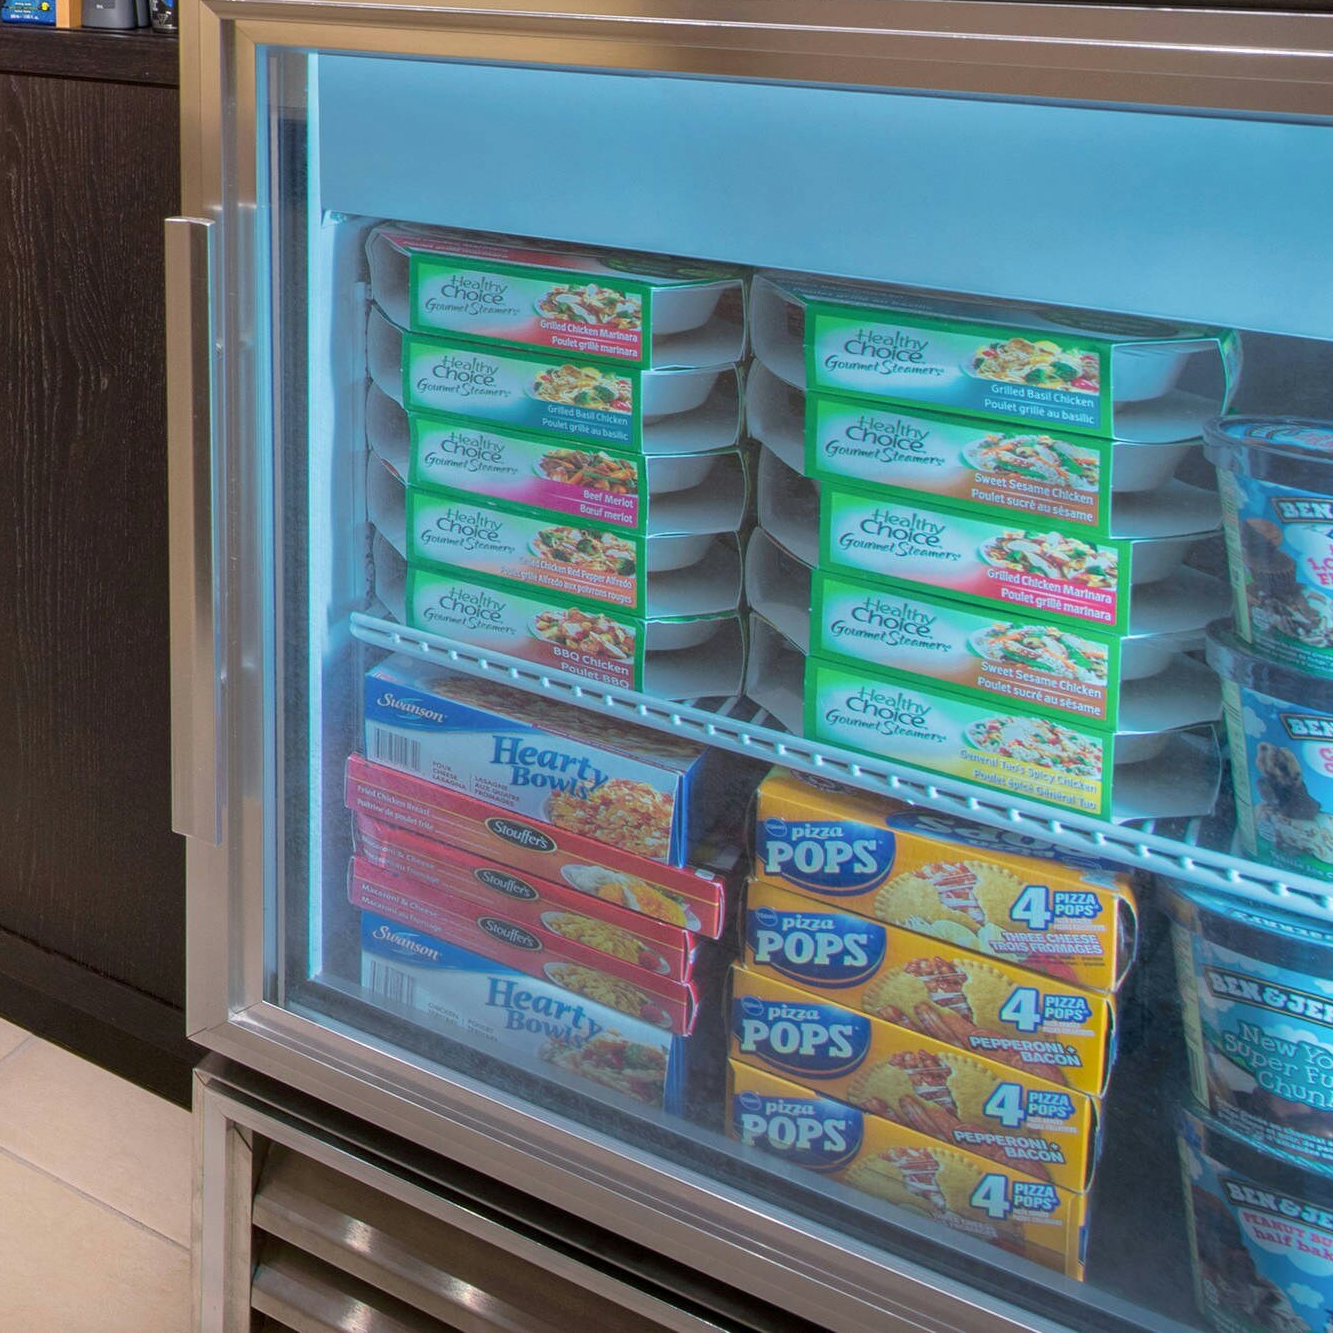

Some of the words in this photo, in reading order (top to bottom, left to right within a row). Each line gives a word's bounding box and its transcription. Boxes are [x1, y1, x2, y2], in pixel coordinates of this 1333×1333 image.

[441, 284, 505, 306] Choice
[451, 274, 508, 294] Healthy
[425, 297, 468, 316] Gourmet
[540, 319, 565, 332] Grilled
[567, 322, 597, 337] Chicken
[600, 327, 638, 342] Marinara
[583, 490, 601, 500] Beef
[603, 493, 634, 508] Merlot
[377, 692, 444, 724] Swanson
[490, 736, 608, 787] Hearty
[509, 766, 589, 801] Bowls
[493, 820, 547, 848] Stouffer's
[791, 823, 844, 841] pizza
[765, 838, 879, 874] POPS
[970, 1036, 1063, 1054] PEPPERONI
[1022, 1051, 1082, 1067] BACON
